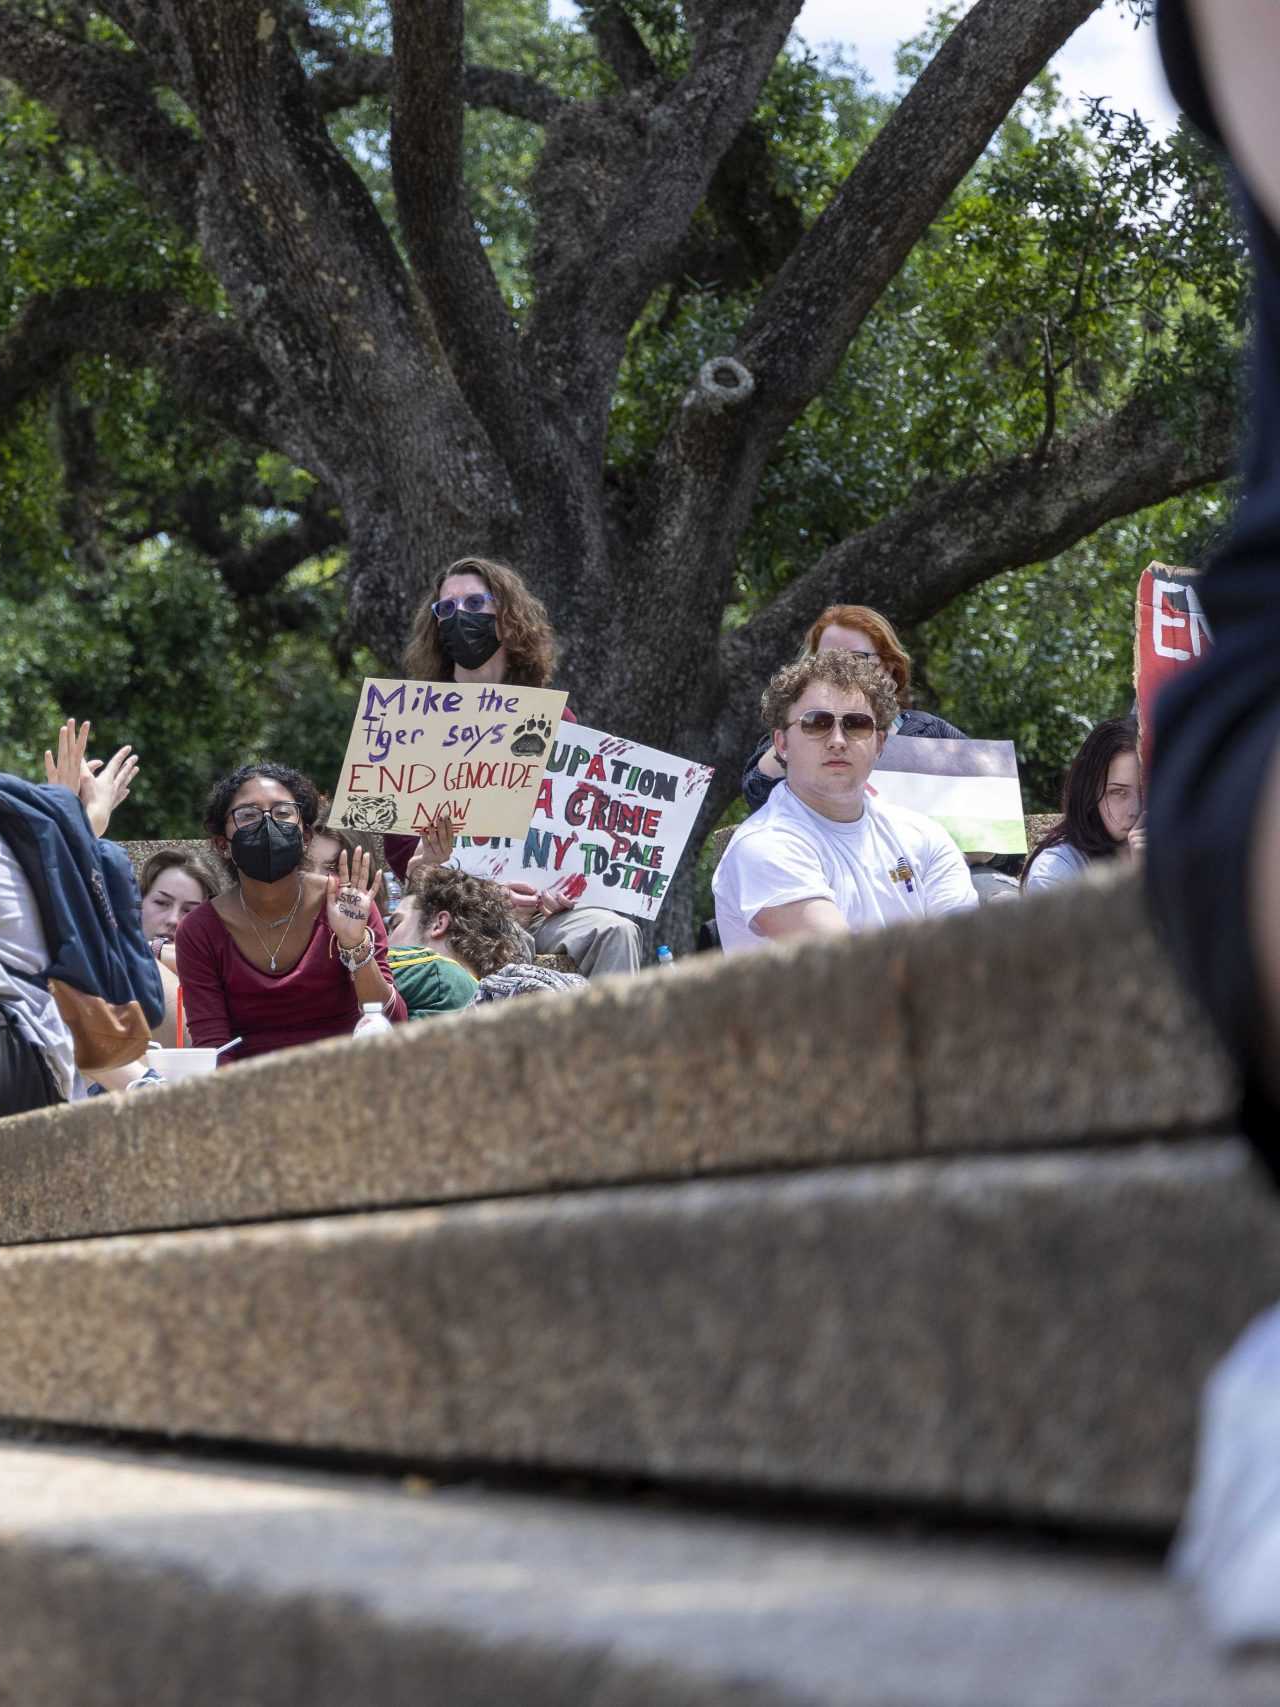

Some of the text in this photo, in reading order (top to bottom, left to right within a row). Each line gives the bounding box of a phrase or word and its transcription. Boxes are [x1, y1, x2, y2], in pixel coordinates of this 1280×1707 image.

[362, 683, 519, 720] Mike the
[441, 722, 507, 757] says
[348, 761, 539, 794] END GENOCIDE
[412, 798, 471, 825] NOW
[534, 778, 663, 838] A CRIME
[610, 836, 665, 869] PALE
[602, 861, 671, 899] STINE
[335, 892, 362, 906] STOP
